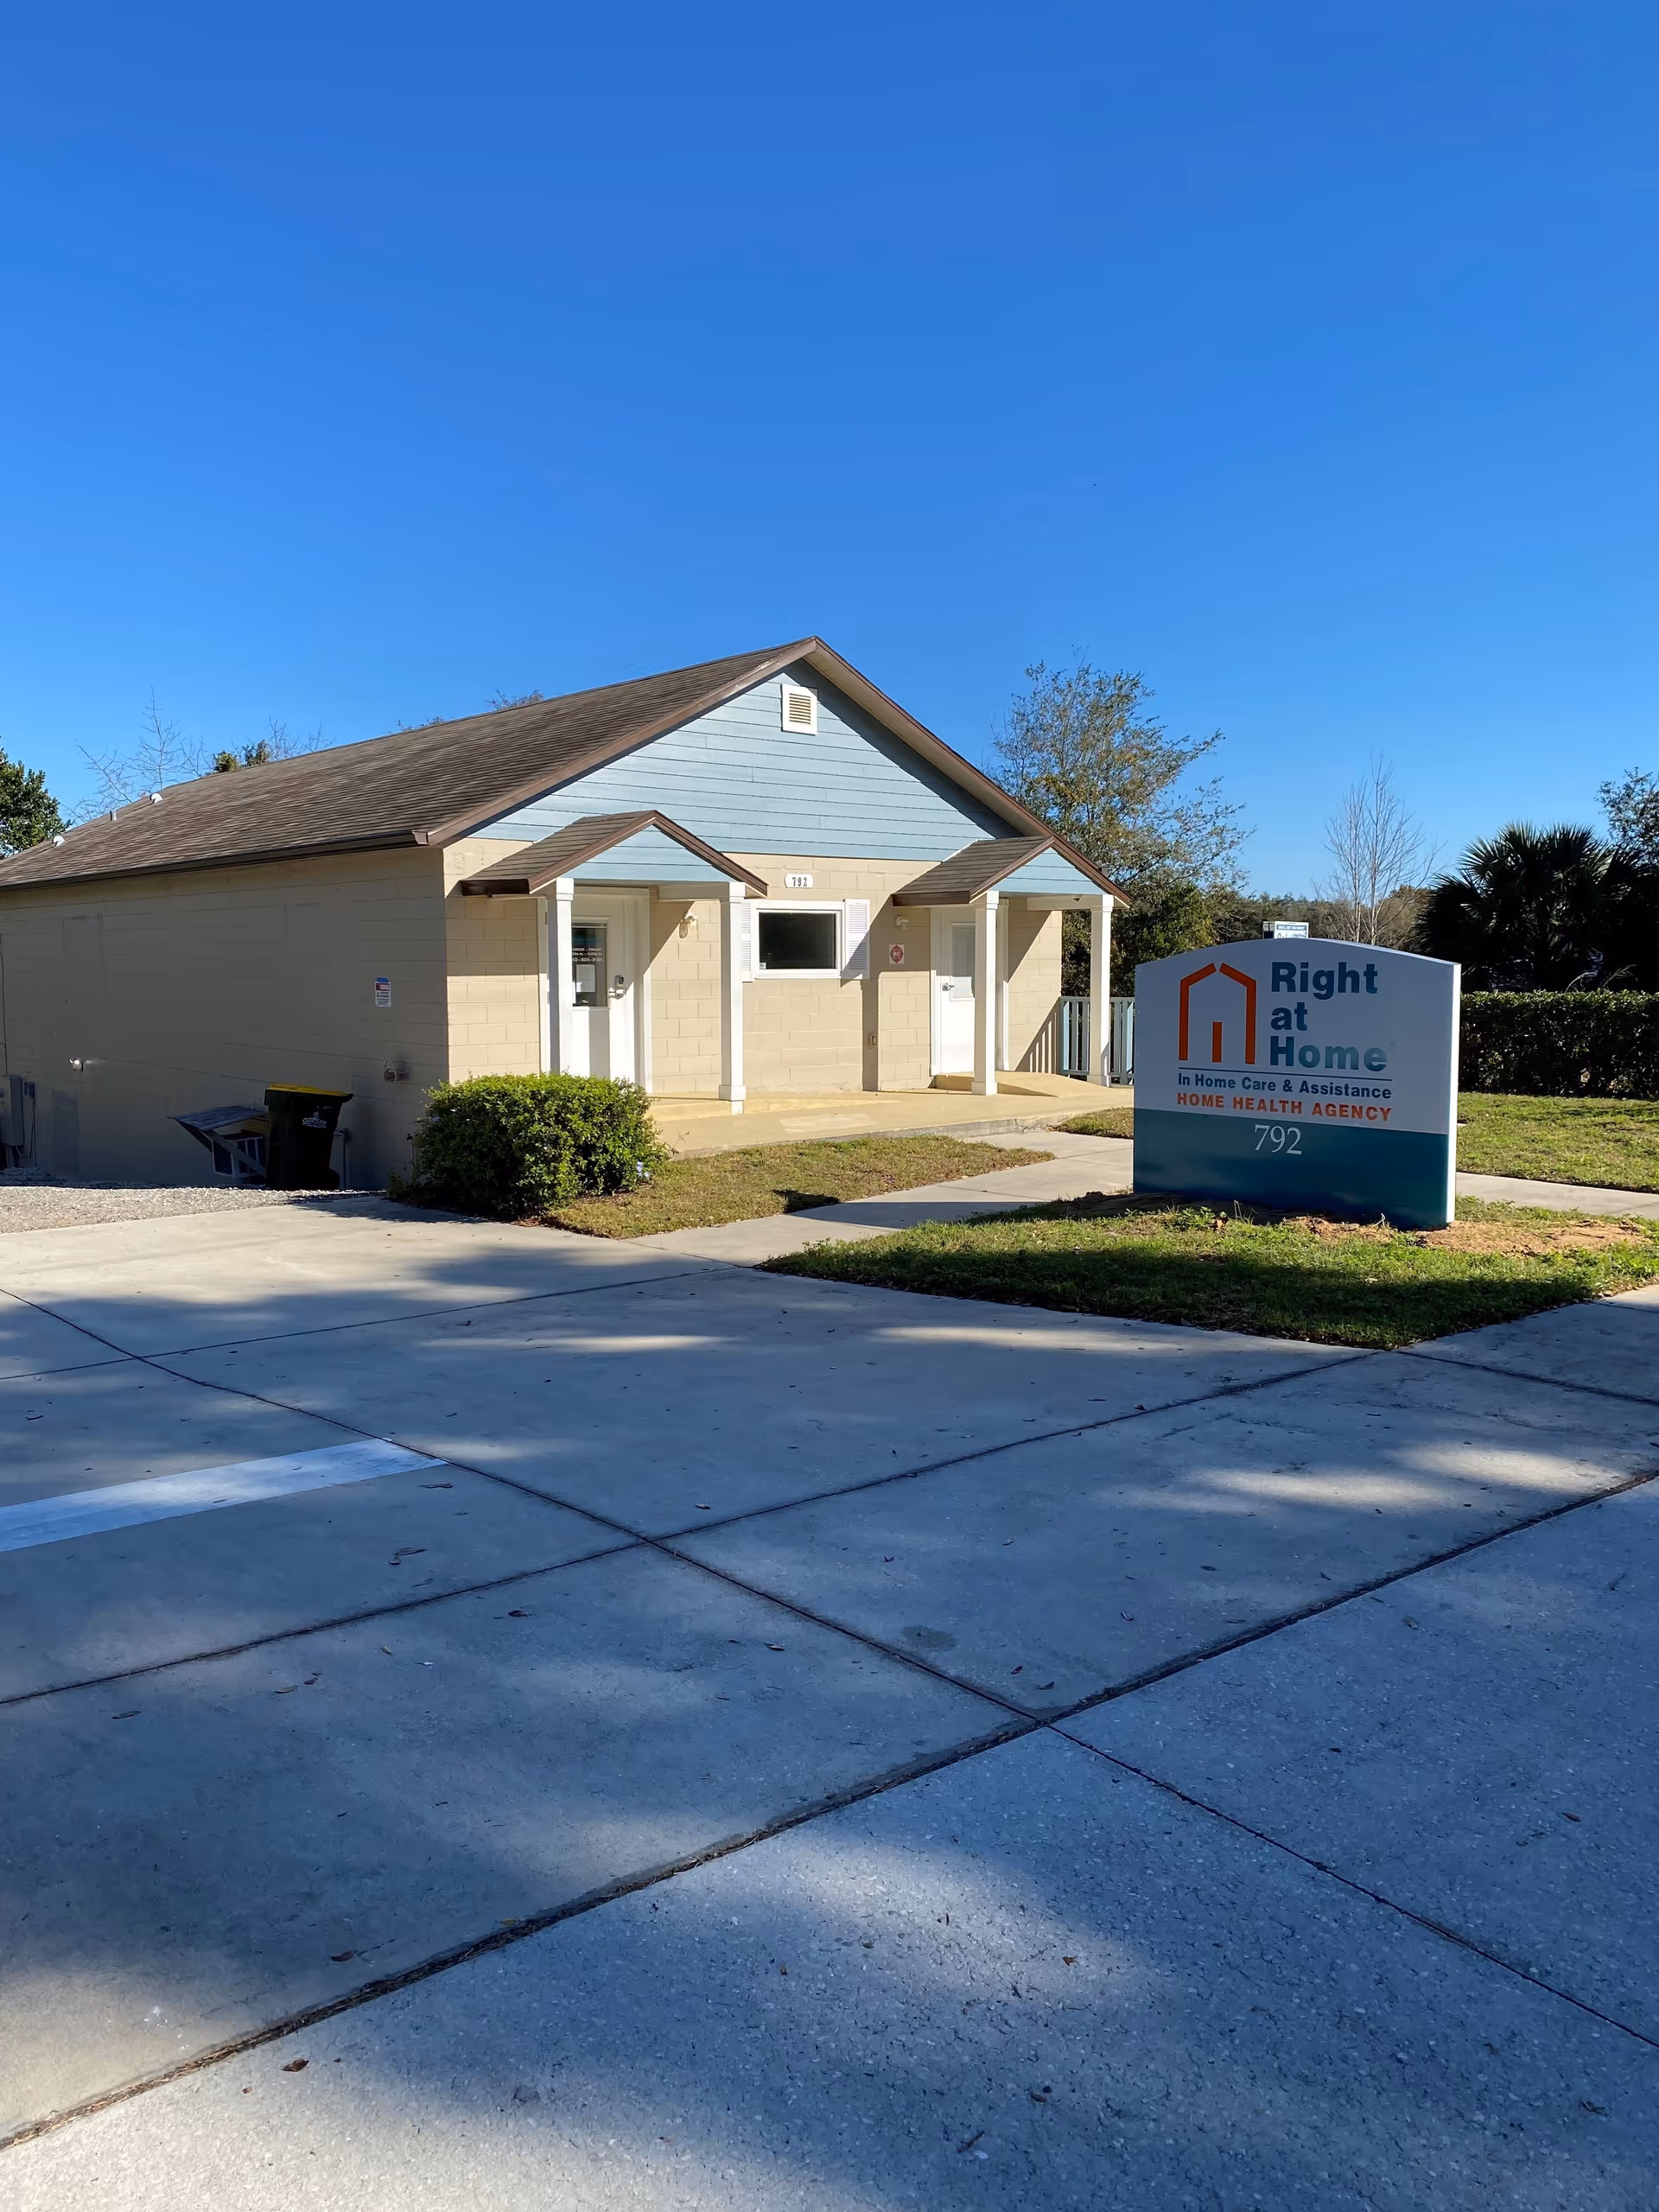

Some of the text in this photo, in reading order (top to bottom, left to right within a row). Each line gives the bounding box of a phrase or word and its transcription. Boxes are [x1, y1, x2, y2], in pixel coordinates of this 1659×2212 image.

[791, 877, 808, 887] 792
[1271, 962, 1378, 1000] Right
[1270, 1002, 1307, 1031] at
[1269, 1036, 1388, 1071] Home
[1178, 1072, 1392, 1099] In Home Care & Assistance
[1177, 1092, 1392, 1122] HOME HEALTH AGENCY
[1255, 1123, 1302, 1155] 792
